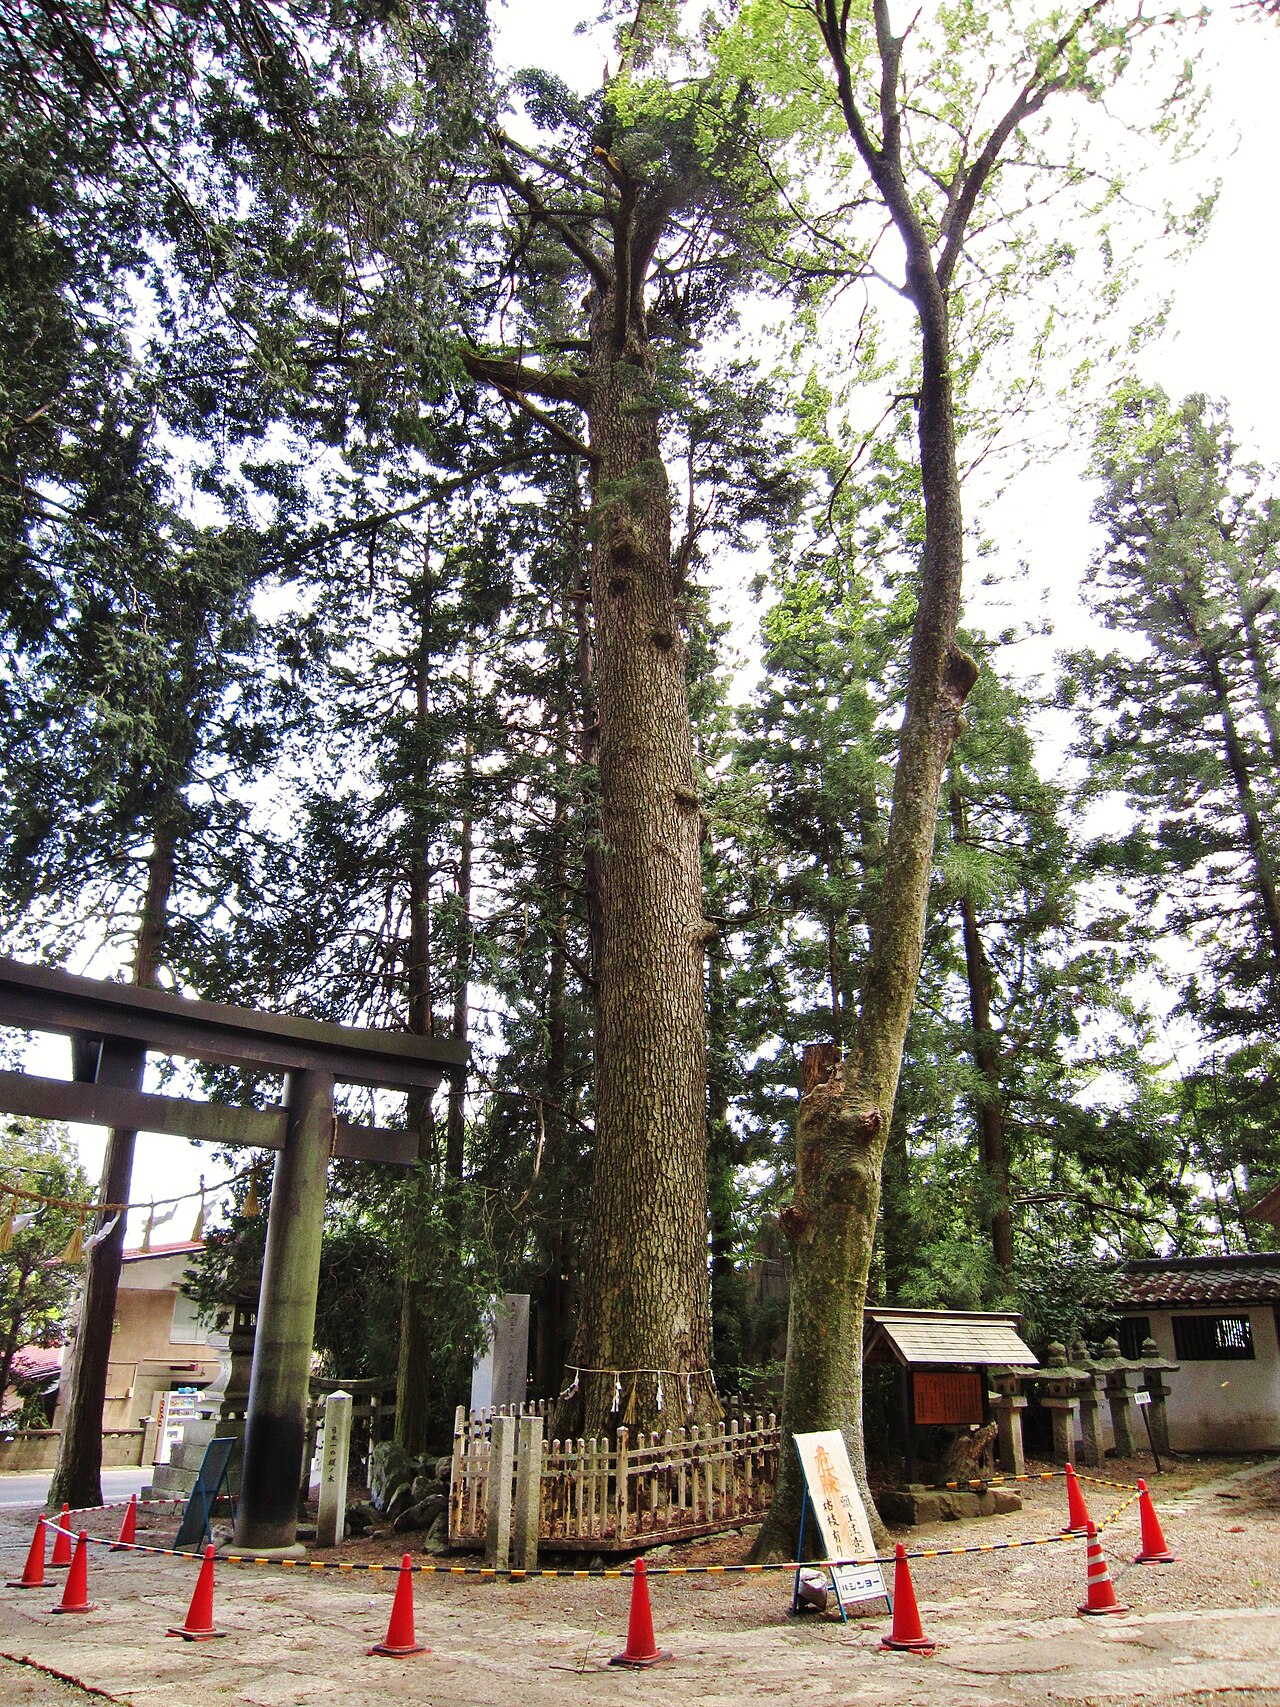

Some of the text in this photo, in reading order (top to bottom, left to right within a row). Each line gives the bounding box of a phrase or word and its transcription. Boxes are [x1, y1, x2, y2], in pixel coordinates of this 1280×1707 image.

[814, 1444, 841, 1498] 危険
[840, 1494, 866, 1555] 頭上注意
